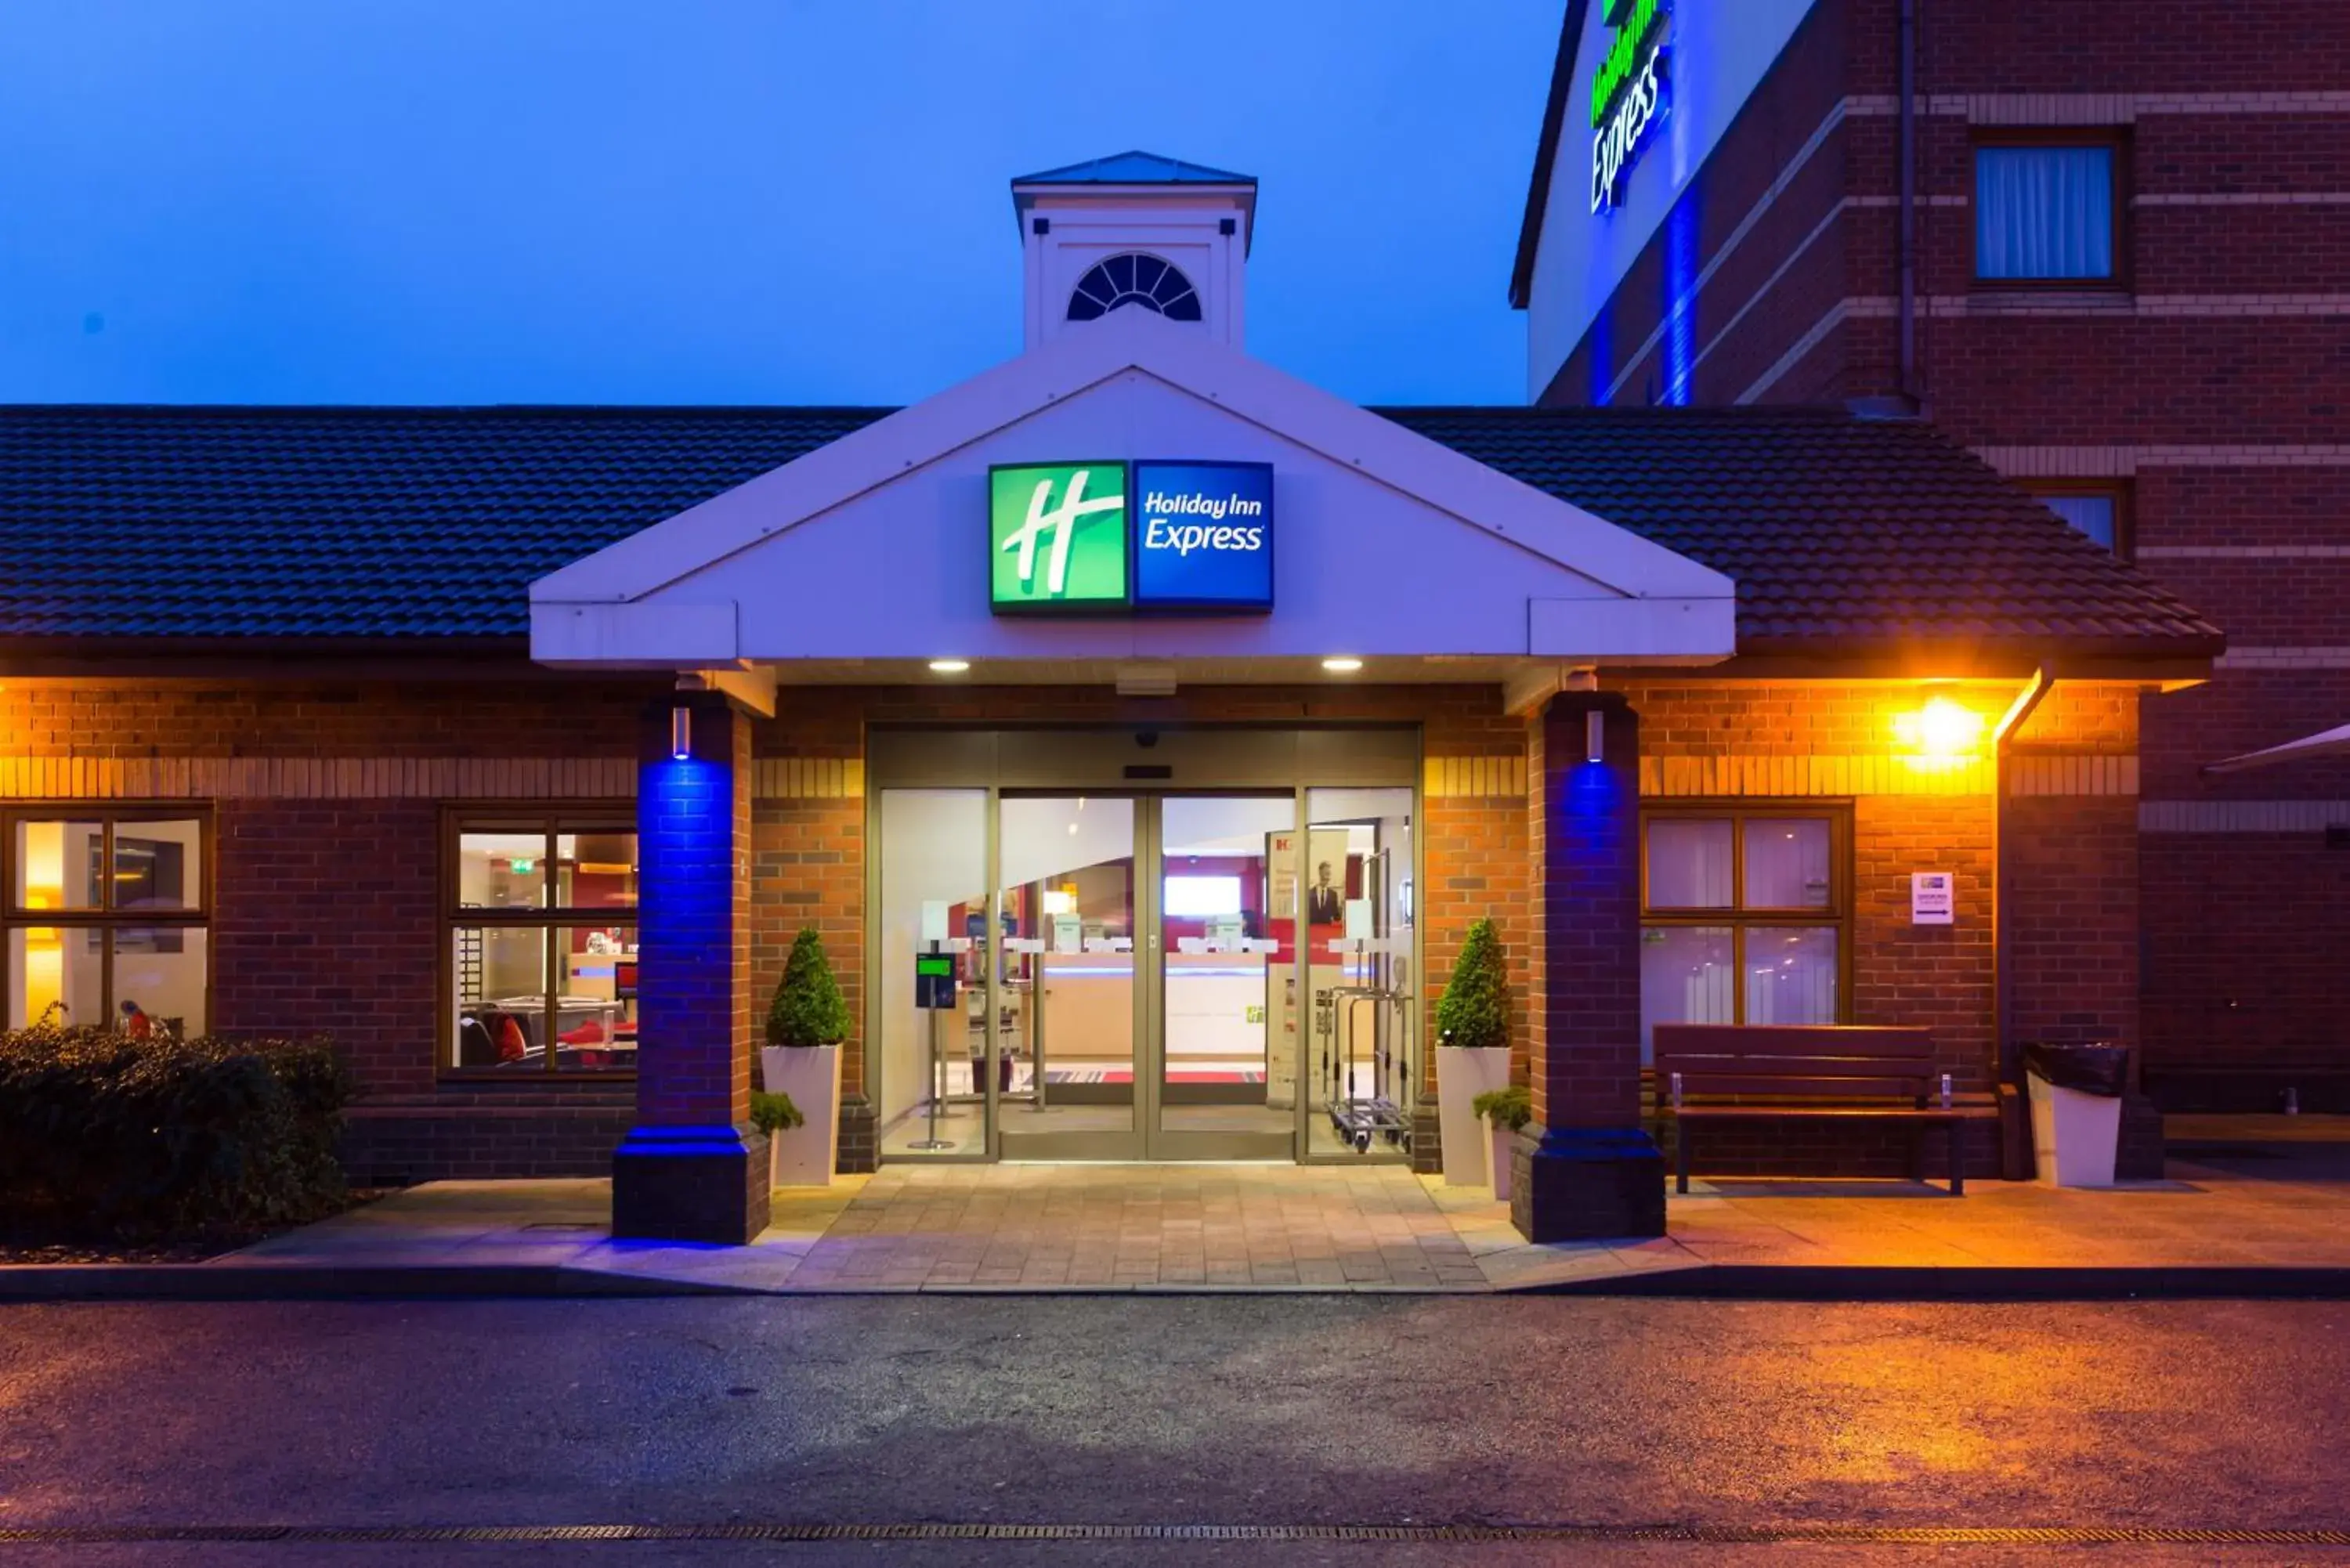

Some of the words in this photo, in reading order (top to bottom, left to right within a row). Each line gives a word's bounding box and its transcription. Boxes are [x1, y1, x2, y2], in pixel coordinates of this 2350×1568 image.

[1591, 45, 1660, 214] Express
[1002, 470, 1124, 592] H
[1144, 491, 1227, 519] Holiday
[1228, 493, 1262, 515] Inn
[1144, 518, 1263, 557] Express
